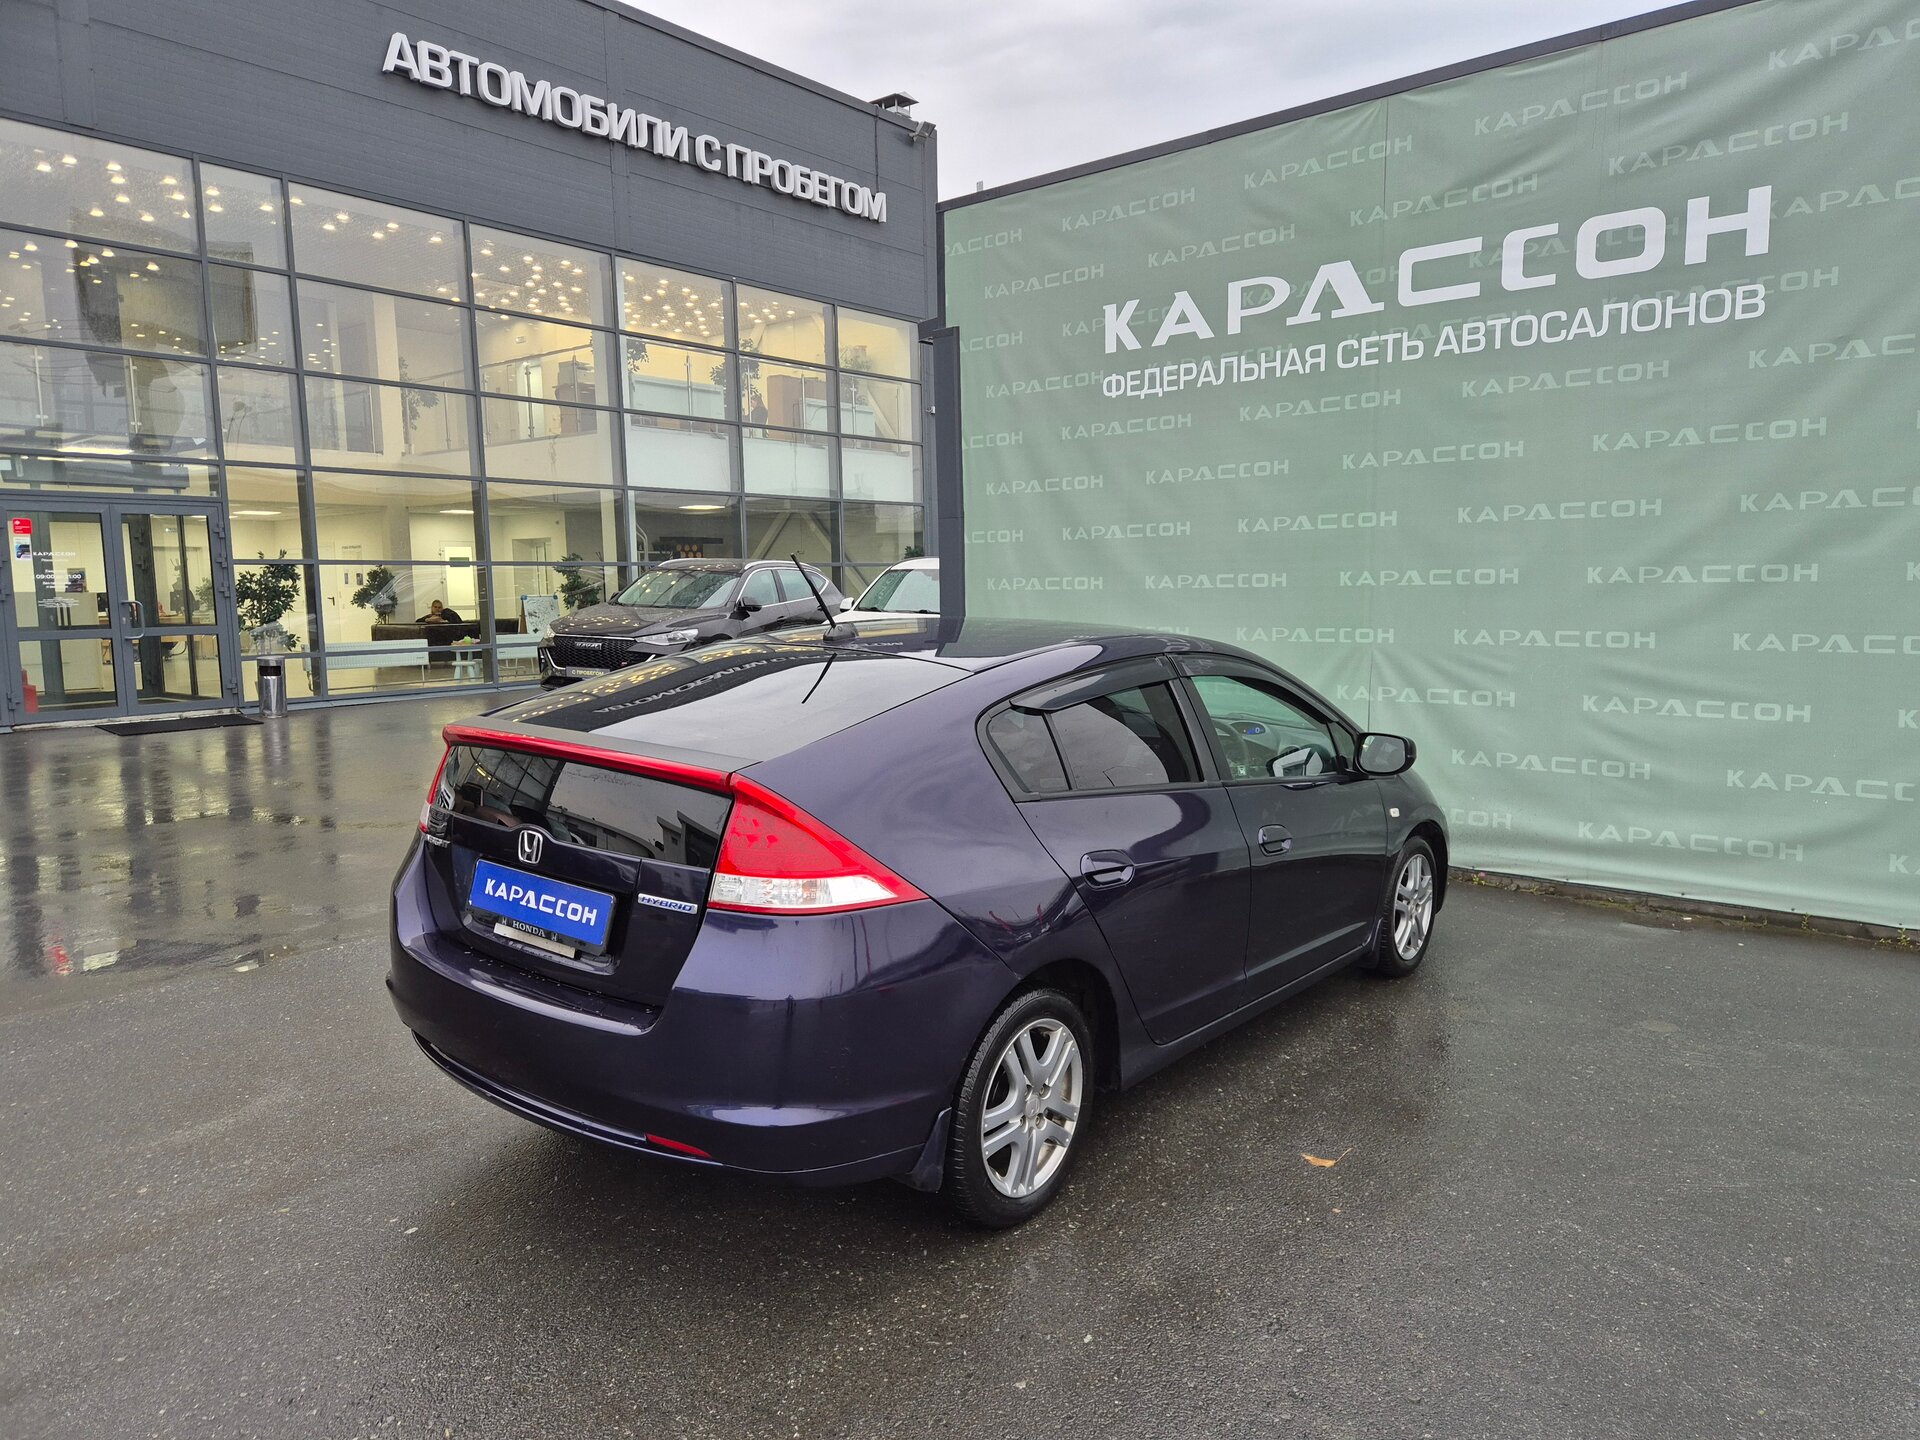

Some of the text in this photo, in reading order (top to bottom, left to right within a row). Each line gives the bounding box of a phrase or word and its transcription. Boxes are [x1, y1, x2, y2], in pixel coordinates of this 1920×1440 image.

[1474, 71, 1688, 136] КАРАССОН
[382, 32, 887, 223] АВТОМОБИЛИ С ПРОБЕГОМ
[1608, 111, 1849, 177] КАРАССОН
[1244, 134, 1412, 190] КАРАССОН
[1061, 187, 1196, 232] КАРАССОН
[1350, 173, 1538, 227] КАРАССОН
[1147, 223, 1296, 268] КАРАССОН
[984, 263, 1104, 299] КАРАССОН
[1103, 185, 1772, 354] КАРАССОН
[1103, 283, 1767, 399] ФЕДЕРАЛЬНАЯ СЕТЬ АВТОСАЛОНОВ
[986, 370, 1104, 398] КАРАССОН
[1461, 359, 1669, 399] КАРАССОН
[1240, 389, 1401, 422] КАРАССОН
[1062, 412, 1192, 440] КАРАССОН
[1593, 416, 1827, 452] КАРАССОН
[1342, 440, 1524, 470] КАРАССОН
[986, 474, 1103, 496] КАРАССОН
[1146, 460, 1289, 485] КАРАССОН
[1238, 510, 1397, 533] КАРАССОН
[1457, 498, 1662, 524] КАРАССОН
[965, 529, 1023, 544] ССОН
[1062, 521, 1191, 541] КАРАССОН
[987, 576, 1103, 591] КАРАССОН
[1145, 572, 1287, 589] КАРАССОН
[1339, 568, 1519, 586] КАРАССОН
[1587, 563, 1819, 584] КАРАССОН
[1236, 626, 1395, 644] КАРАССОН
[1454, 628, 1656, 649] КАРАССОН
[1337, 684, 1516, 707] КАРАССОН
[1582, 694, 1811, 723] КАРАССОН
[1451, 748, 1651, 780] КАРАССОН
[1577, 821, 1804, 862] КАРАССОН
[484, 878, 598, 926] КАРАССОН
[641, 896, 693, 912] HYBRID
[512, 920, 546, 938] HONDA
